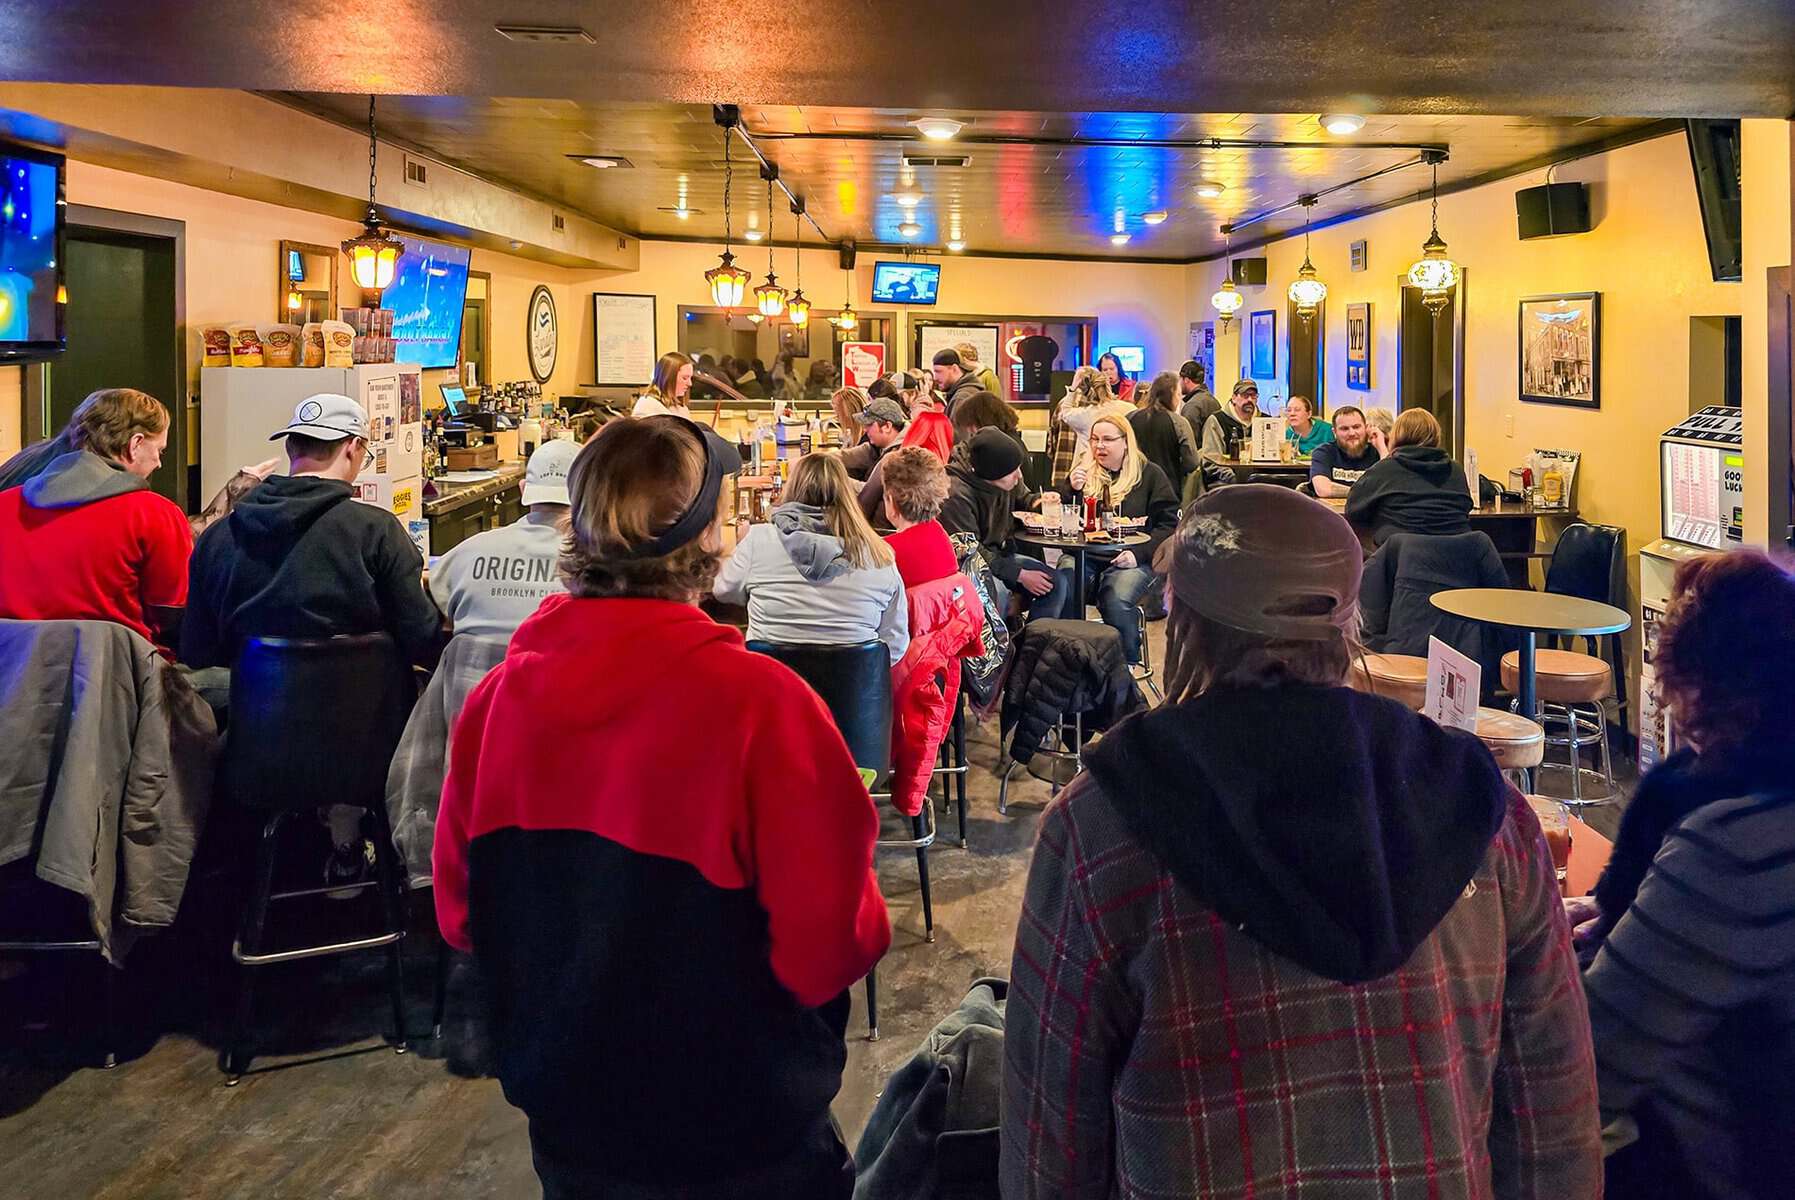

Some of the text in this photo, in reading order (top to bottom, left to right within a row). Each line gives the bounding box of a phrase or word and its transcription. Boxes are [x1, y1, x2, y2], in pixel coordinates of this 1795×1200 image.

[1679, 415, 1728, 429] PULL
[1724, 470, 1743, 482] GOO
[490, 587, 536, 598] BROOKLYN
